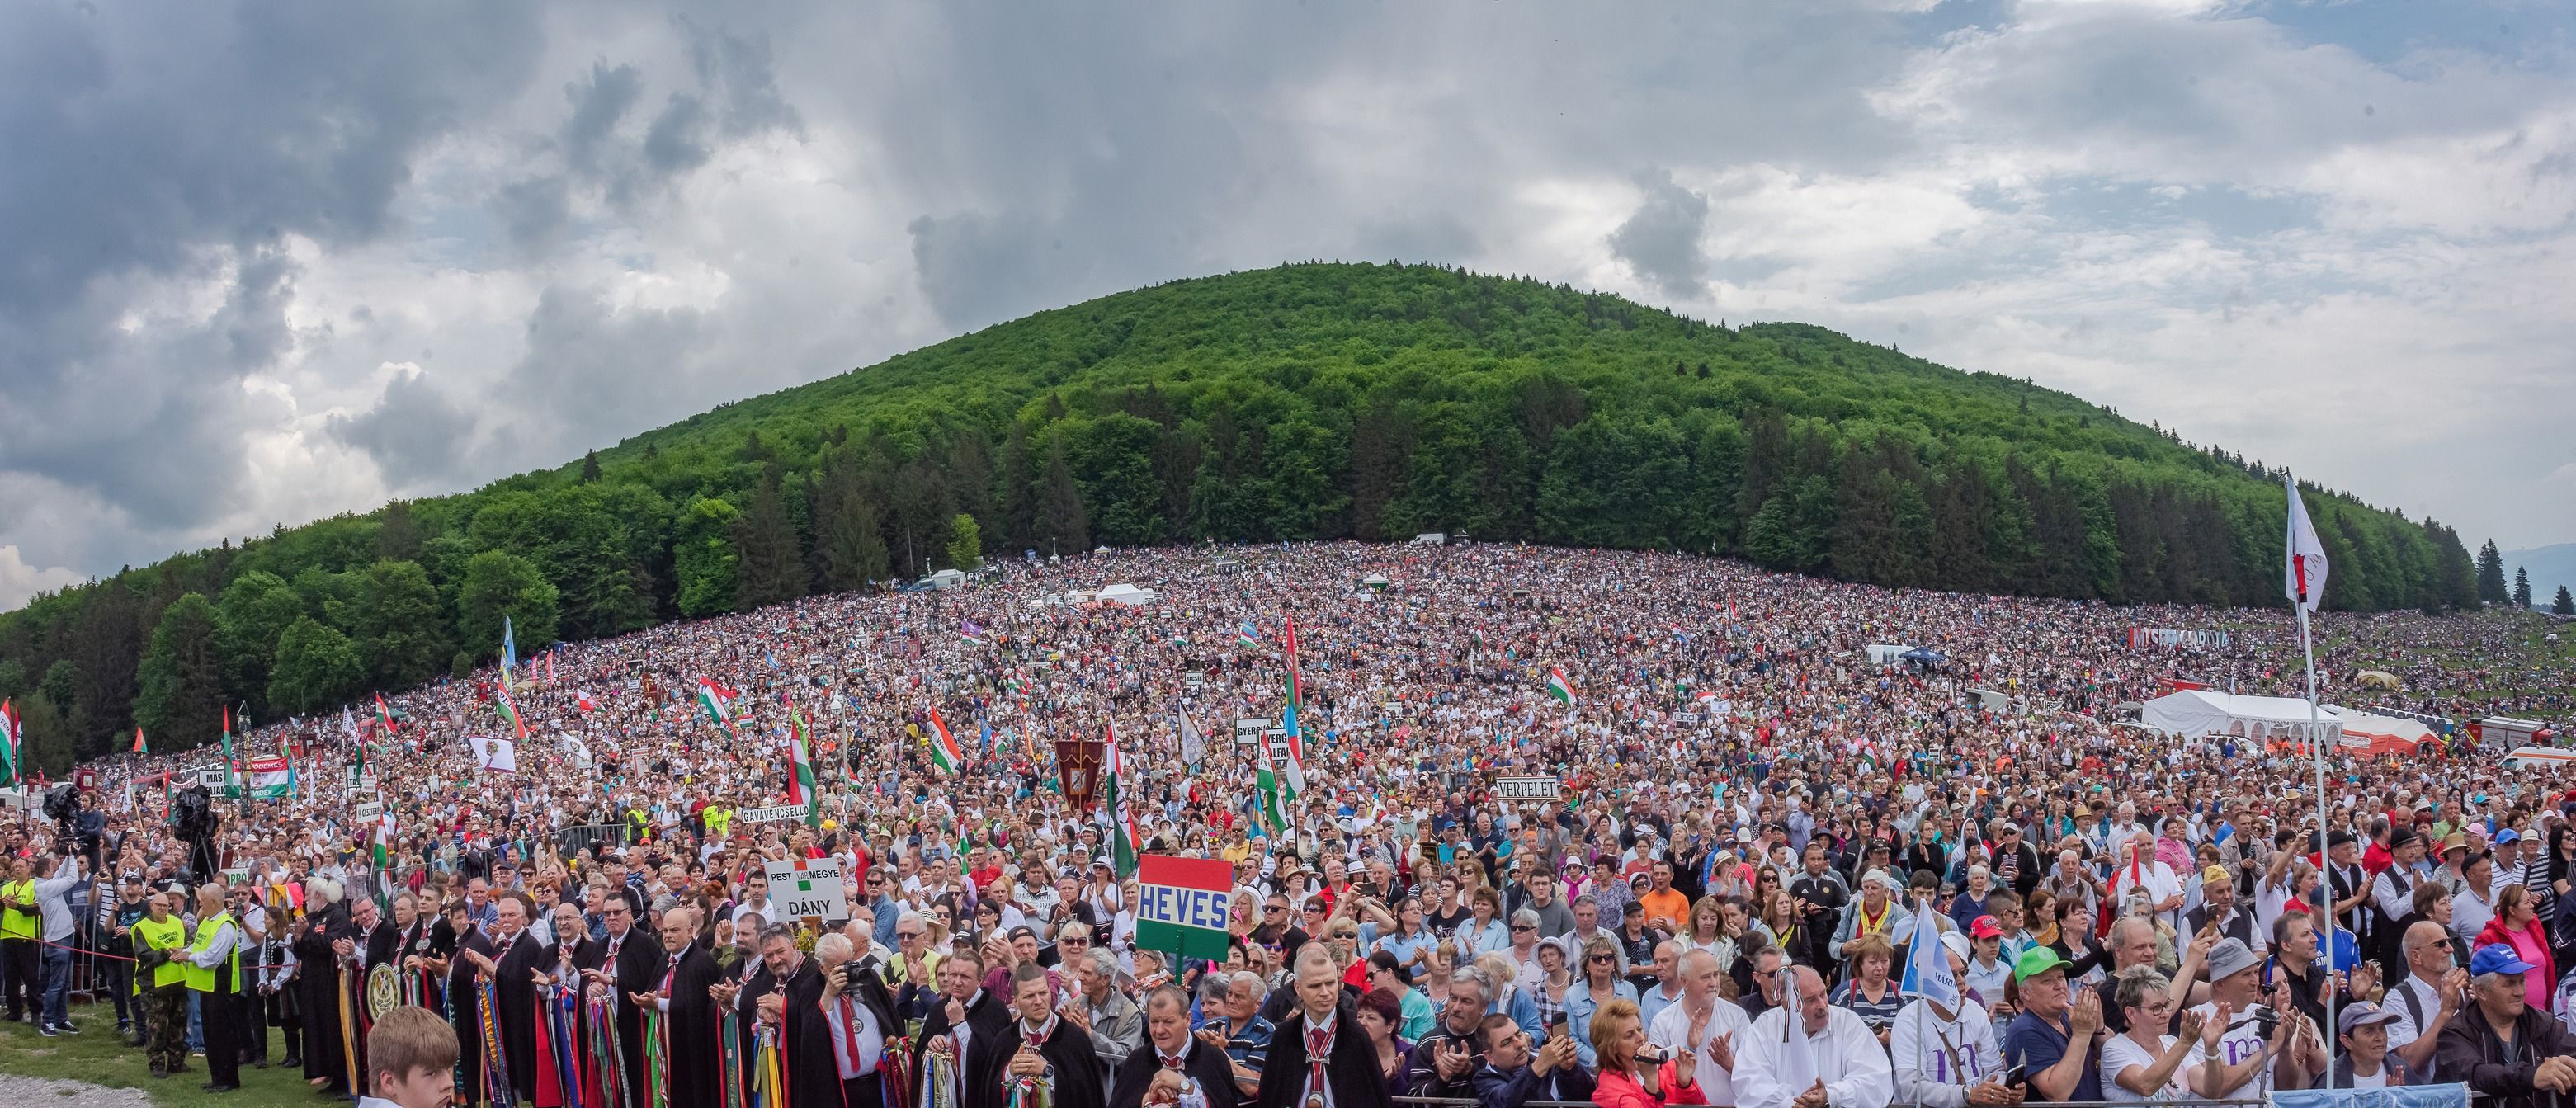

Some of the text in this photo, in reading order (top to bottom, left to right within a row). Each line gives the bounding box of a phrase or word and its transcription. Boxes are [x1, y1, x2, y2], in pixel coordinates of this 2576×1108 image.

[1238, 724, 1271, 737] GYERÓ
[206, 772, 223, 784] MÁS
[1498, 778, 1555, 797] VERPELÉT
[771, 872, 792, 882] PEST
[809, 869, 840, 879] MEGYE
[788, 897, 831, 916] DÁNY
[1139, 885, 1227, 929] HEVES
